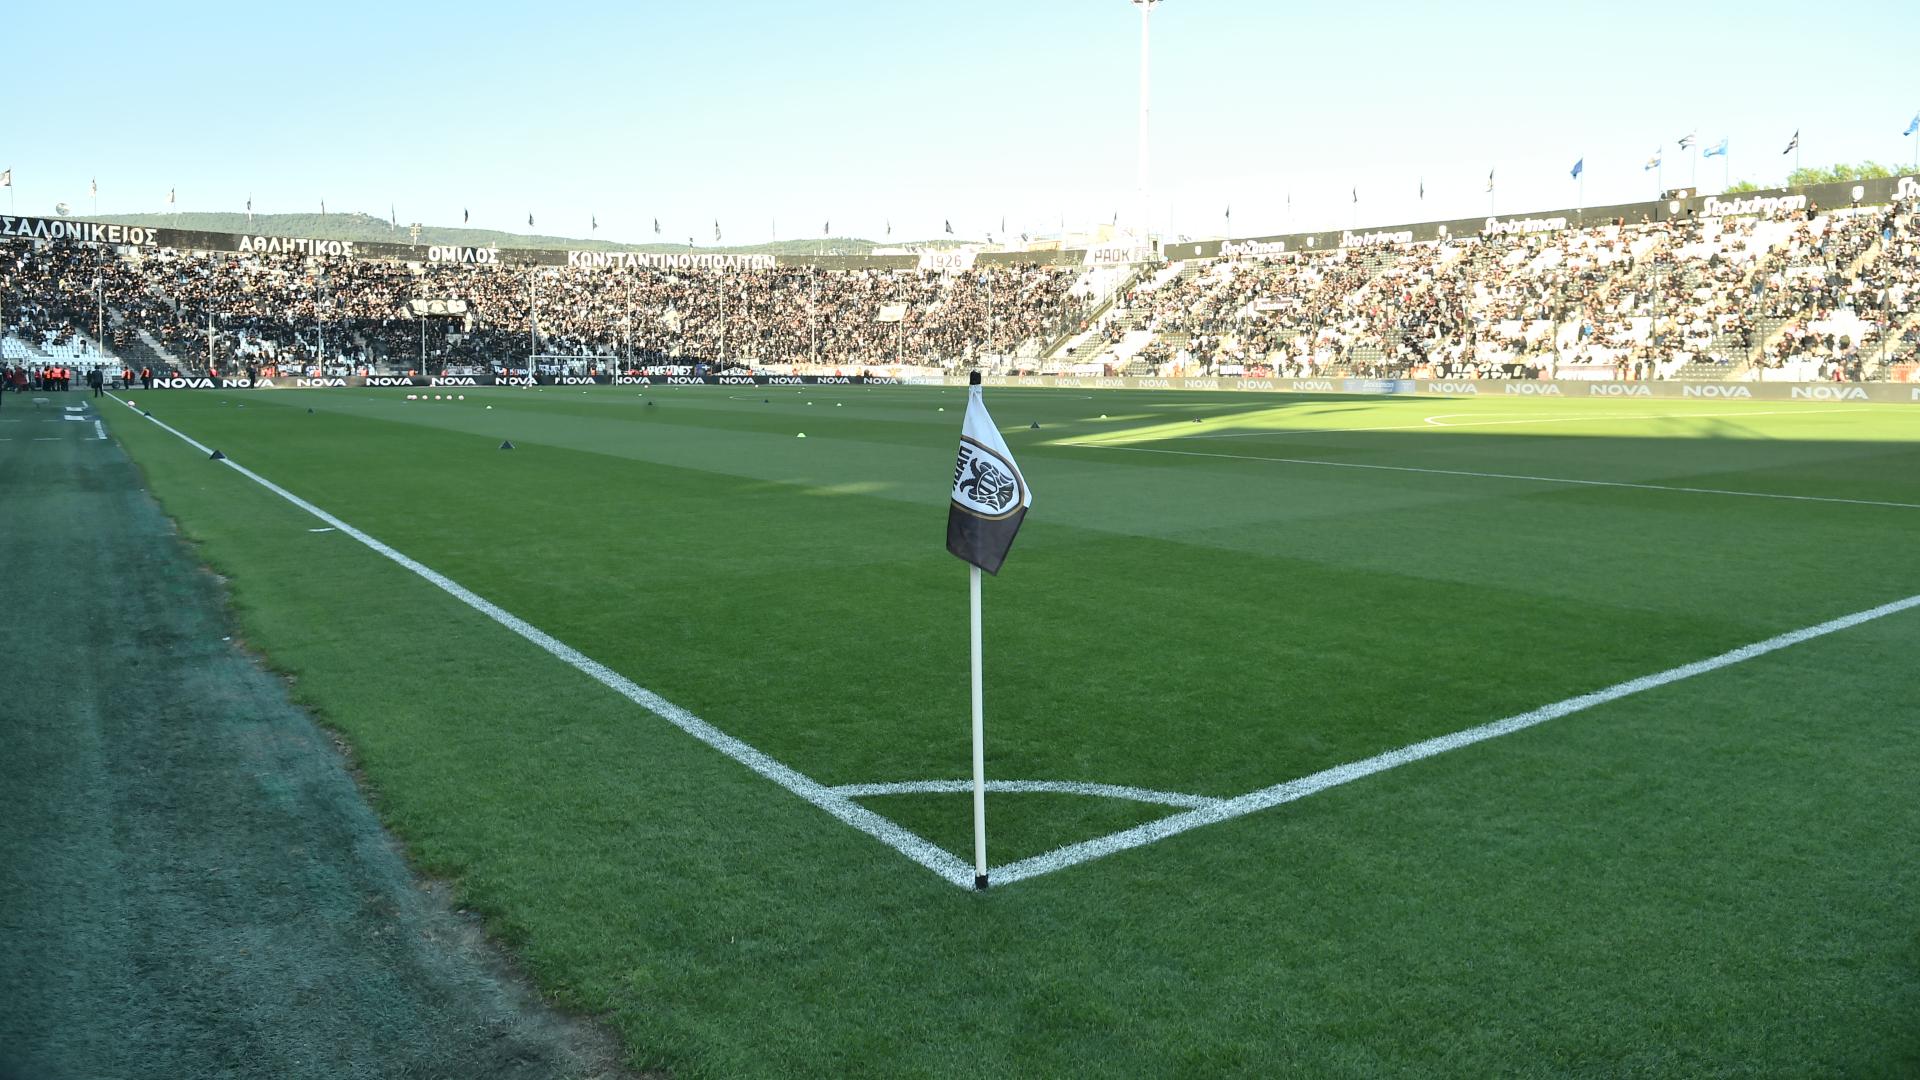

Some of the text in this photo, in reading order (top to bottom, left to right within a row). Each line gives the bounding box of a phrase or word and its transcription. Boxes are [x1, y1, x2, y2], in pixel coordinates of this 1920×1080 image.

[1699, 194, 1807, 218] Stoiximan
[1484, 216, 1567, 235] Stoiximan
[0, 216, 776, 269] ΣΑΛΟΝΙΚΕΙΟΣ ΑΘΛΗΤΙΚΟΣ ΟΜΙΛΟΣ ΚΩΝΣΤΑΝΤΙΝΟΥΠΟΛΙΤΩΝ
[1339, 230, 1413, 248] Stoiximan
[1218, 240, 1285, 256] Stoiximan
[1094, 248, 1130, 262] PAOK
[930, 255, 961, 267] 1926
[153, 378, 215, 388] NOVA
[222, 379, 275, 388] NOVA
[297, 378, 347, 387] NOVA
[366, 377, 413, 386] NOVA
[431, 377, 477, 385] NOVA
[495, 377, 538, 385] NOVA
[863, 377, 898, 385] NOVA
[983, 377, 1007, 385] NOVA
[1055, 378, 1081, 386] NOVA
[1096, 379, 1124, 387] NOVA
[1139, 379, 1170, 388] NOVA
[1185, 380, 1218, 388] NOVA
[1237, 380, 1274, 389] NOVA
[1293, 381, 1333, 390] NOVA
[1428, 382, 1478, 393] NOVA
[1505, 383, 1561, 394] NOVA
[1590, 384, 1652, 396] NOVA
[1683, 385, 1751, 397] NOVA
[1791, 386, 1869, 400] NOVA
